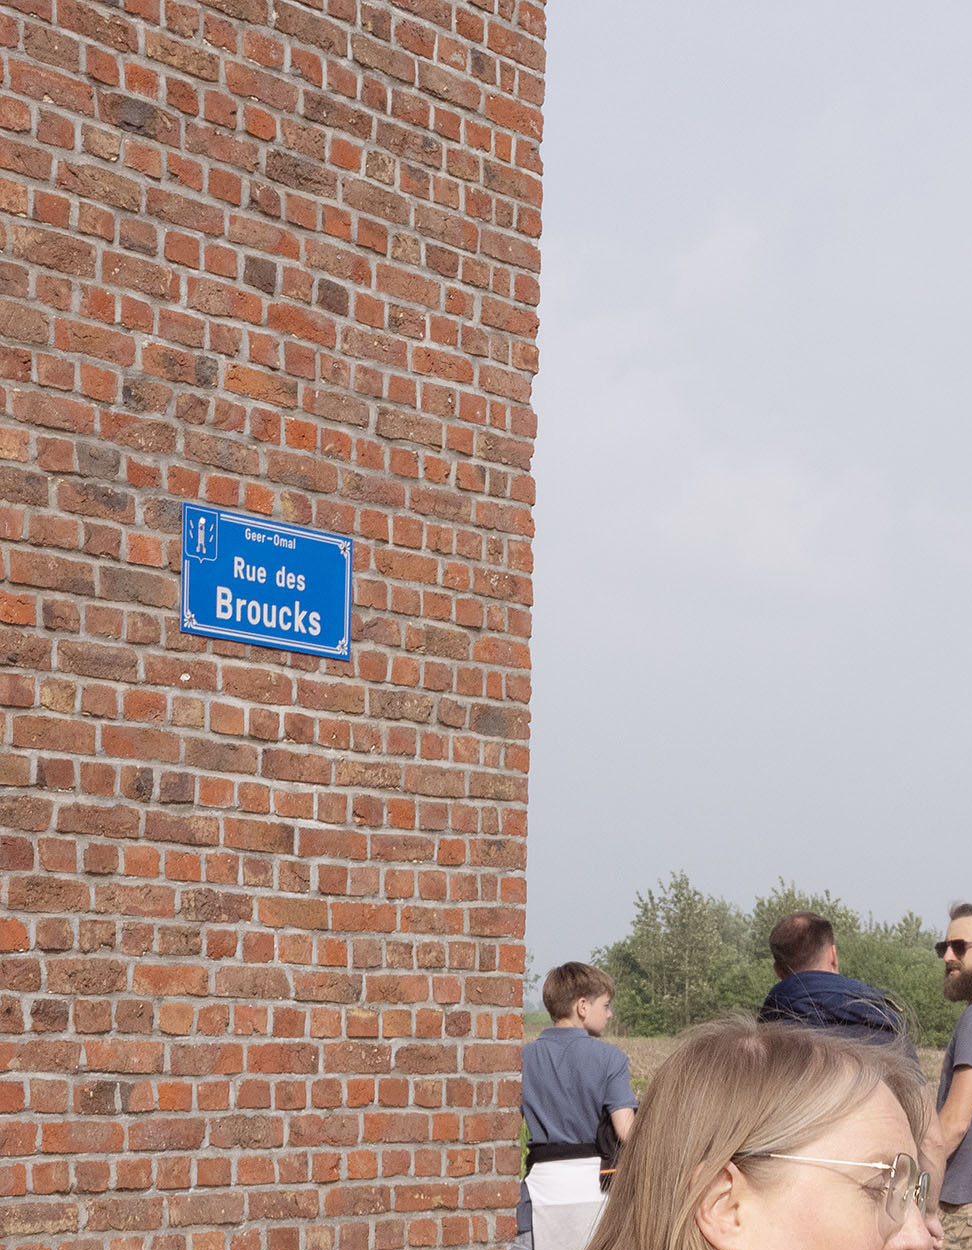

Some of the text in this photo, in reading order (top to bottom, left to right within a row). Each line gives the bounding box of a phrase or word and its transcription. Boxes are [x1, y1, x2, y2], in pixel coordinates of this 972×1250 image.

[244, 527, 296, 550] Geer-Omal
[233, 556, 306, 592] Rue des
[215, 585, 322, 637] Broucks
